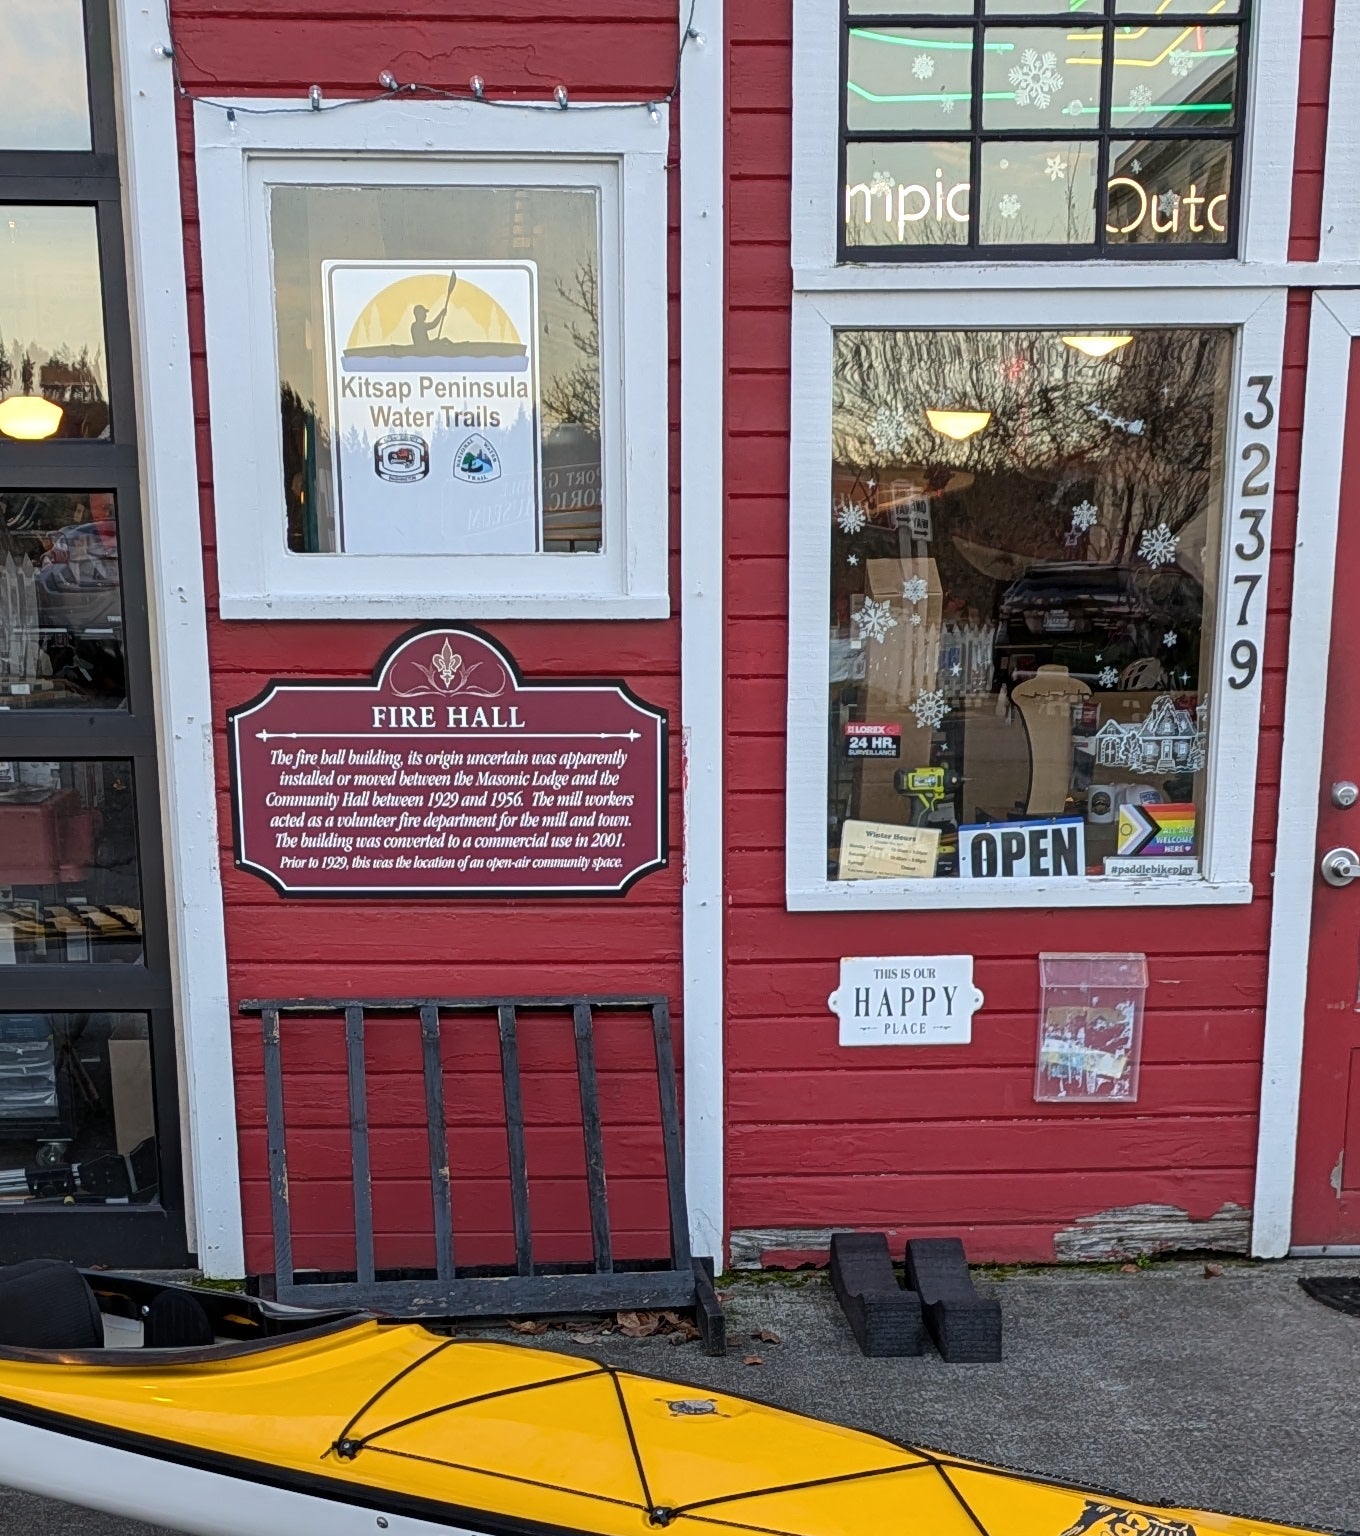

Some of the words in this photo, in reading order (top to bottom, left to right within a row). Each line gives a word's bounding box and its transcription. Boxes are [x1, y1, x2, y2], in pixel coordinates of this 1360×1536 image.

[341, 376, 412, 403] Kitsap
[419, 375, 529, 399] Peninsula
[369, 405, 433, 428] Water
[440, 404, 501, 428] Trails
[372, 706, 436, 728] FIRE
[446, 706, 526, 728] HALL
[855, 726, 886, 734] LOREX
[849, 736, 868, 749] 24
[871, 736, 897, 749] HR.
[270, 750, 293, 765] The
[292, 749, 319, 769] fire
[320, 750, 346, 765] hall
[348, 749, 404, 769] building,
[408, 751, 424, 765] its
[425, 751, 463, 769] origin
[467, 750, 528, 765] uncertain
[532, 754, 557, 765] was
[559, 749, 627, 769] apparently
[280, 770, 334, 786] installed
[337, 774, 351, 786] or
[354, 770, 397, 786] moved
[399, 770, 451, 786] between
[454, 770, 474, 786] the
[475, 771, 530, 786] Masonic
[532, 770, 569, 790] Lodge
[571, 770, 598, 786] and
[600, 770, 619, 786] the
[266, 792, 339, 810] Community
[342, 791, 369, 807] Hall
[372, 791, 424, 807] between
[428, 791, 459, 808] 1929
[461, 791, 488, 807] and
[491, 791, 524, 808] 1956.
[532, 791, 553, 807] The
[557, 791, 583, 807] mill
[585, 791, 634, 807] workers
[270, 812, 306, 827] acted
[308, 816, 322, 827] as
[325, 816, 334, 827] a
[337, 812, 396, 827] volunteer
[395, 812, 421, 831] fire
[423, 812, 497, 831] department
[496, 811, 518, 831] for
[520, 812, 539, 827] the
[542, 812, 568, 827] mill
[570, 812, 596, 827] and
[598, 813, 632, 827] town.
[275, 832, 298, 848] The
[300, 832, 353, 852] building
[356, 837, 381, 848] was
[384, 832, 446, 848] converted
[447, 834, 460, 848] to
[463, 837, 471, 848] a
[474, 832, 549, 848] commercial
[551, 837, 572, 848] use
[575, 833, 589, 848] in
[590, 833, 625, 848] 2001.
[865, 830, 892, 840] Winter
[893, 833, 916, 843] Hours
[1156, 836, 1193, 844] WELCOME
[971, 827, 1078, 878] OPEN
[280, 856, 307, 869] Prior
[308, 858, 319, 869] to
[322, 856, 349, 870] 1929,
[352, 856, 371, 869] this
[373, 859, 394, 869] was
[395, 856, 411, 869] the
[413, 856, 456, 869] location
[457, 856, 470, 871] of
[470, 859, 484, 869] an
[486, 857, 531, 871] open-air
[532, 856, 590, 871] community
[592, 859, 623, 871] space.
[1111, 864, 1193, 876] #paddlebikeplay
[873, 968, 897, 979] THIS
[900, 968, 911, 979] IS
[913, 968, 936, 979] OUR
[854, 986, 958, 1017] HAPPY
[884, 1022, 927, 1034] PLACE
